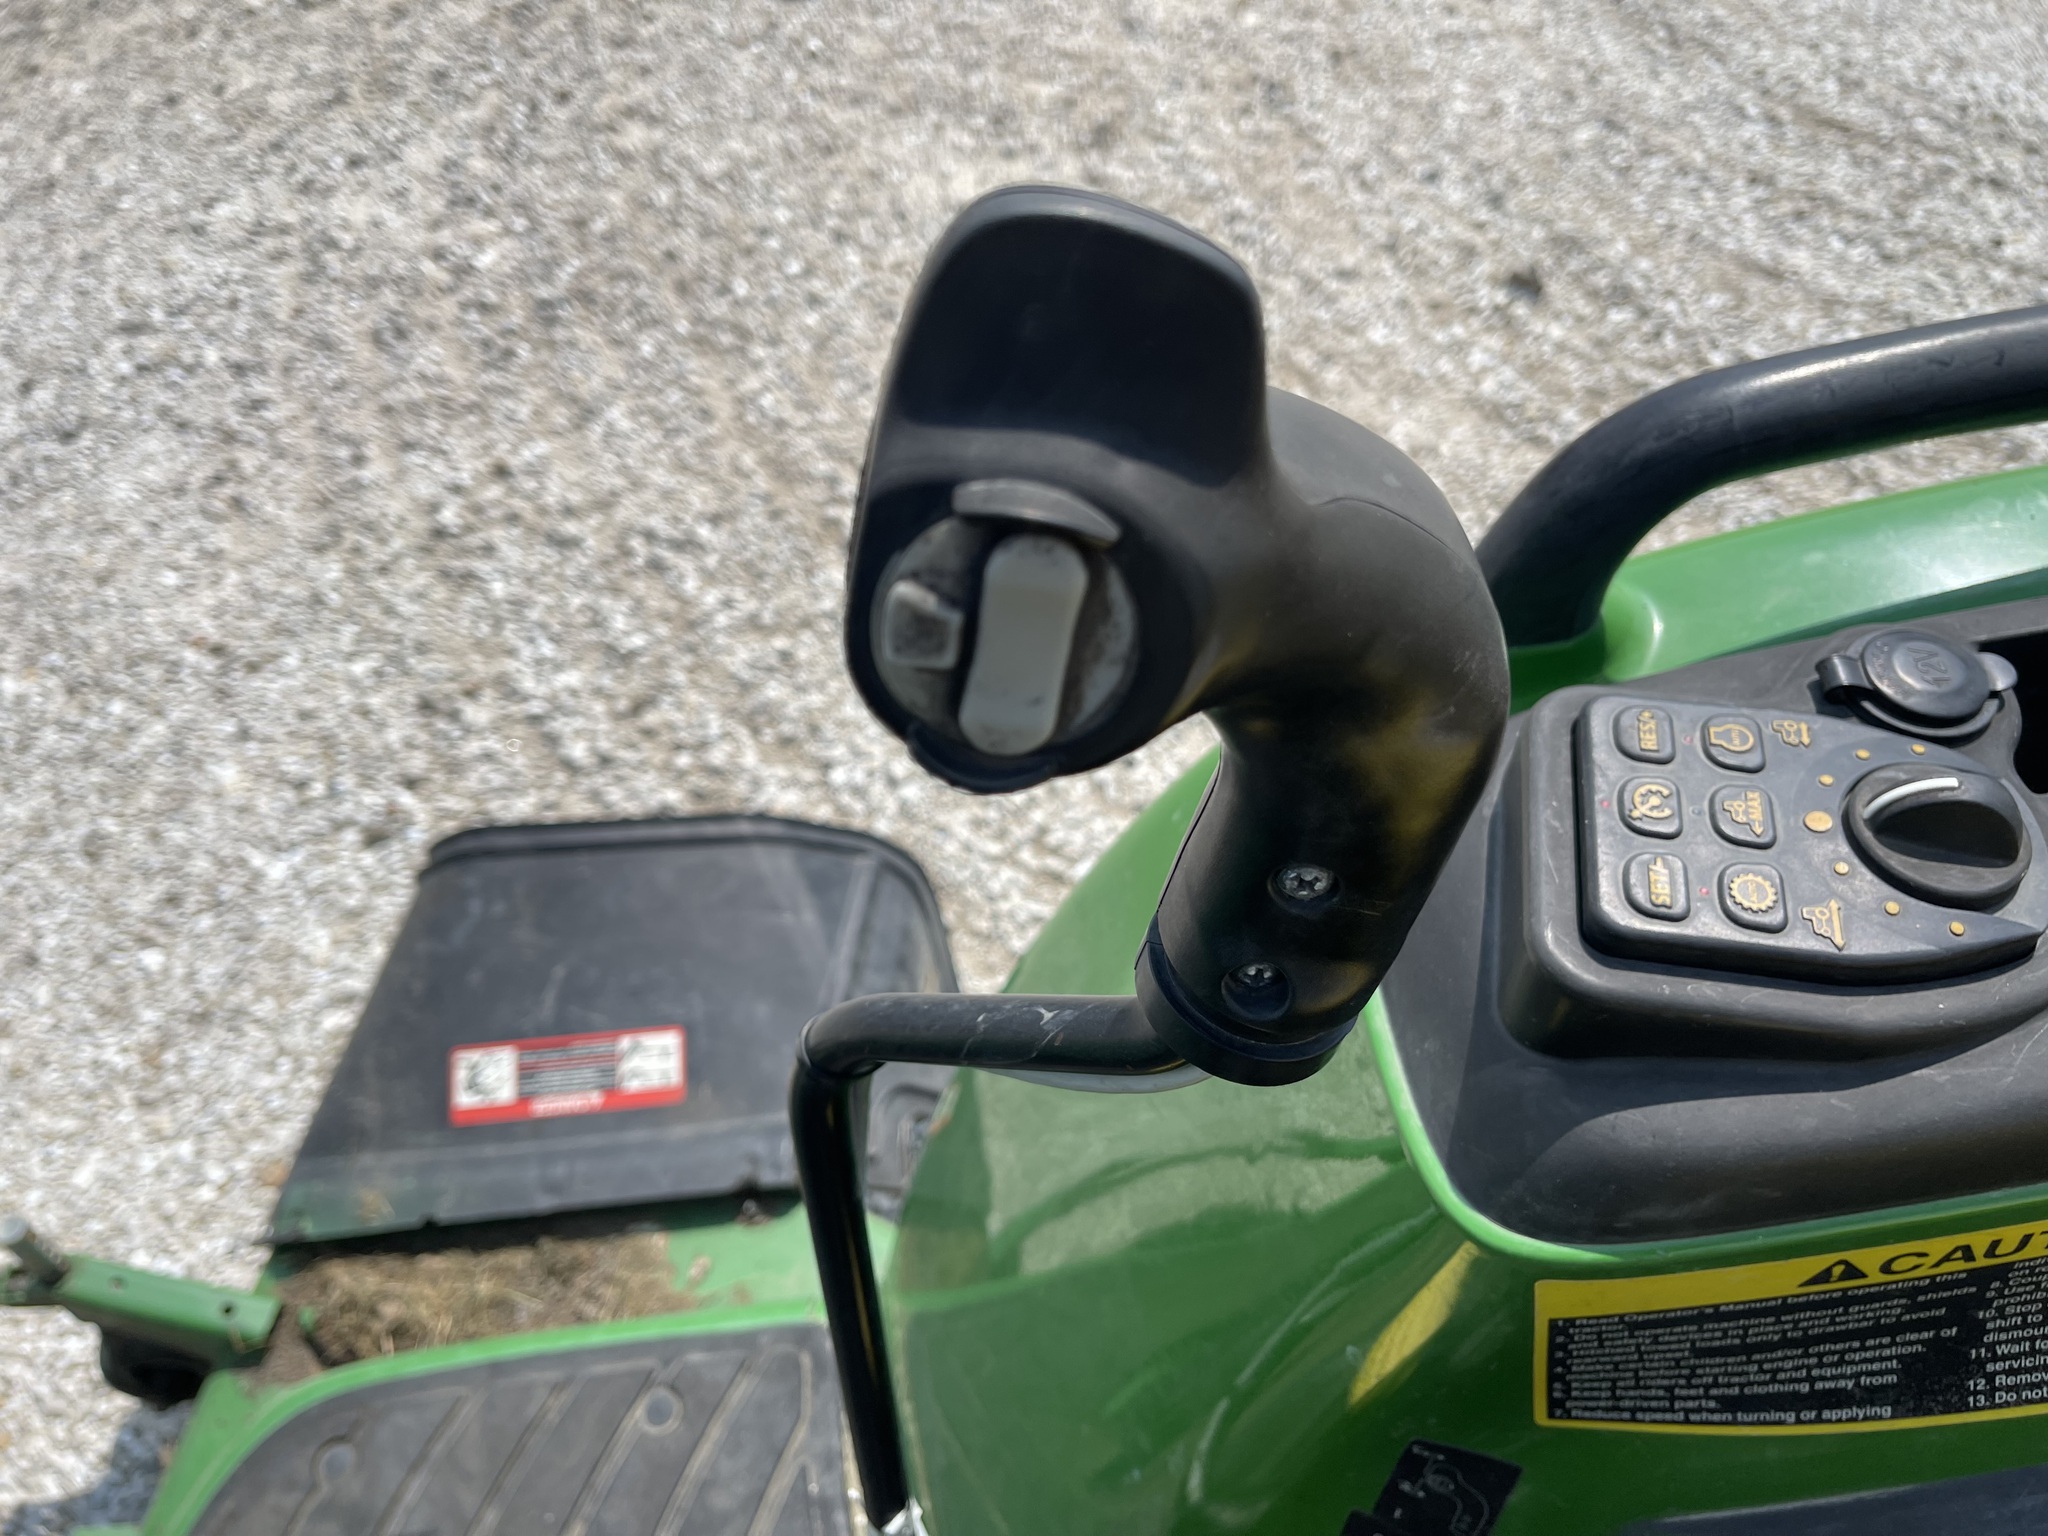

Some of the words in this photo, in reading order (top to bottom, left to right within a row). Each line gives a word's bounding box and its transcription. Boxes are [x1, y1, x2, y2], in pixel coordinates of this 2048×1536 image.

[1906, 647, 1952, 687] 12V
[1879, 1231, 2048, 1275] CAU
[2007, 1268, 2030, 1279] on
[1719, 1298, 1782, 1312] Manual
[1787, 1290, 1843, 1304] before
[1847, 1278, 1931, 1296] operating
[1935, 1272, 1968, 1283] this
[1992, 1291, 2048, 1309] prohib
[2003, 1284, 2036, 1296] Use
[1703, 1316, 1776, 1330] machine
[1780, 1307, 1844, 1321] without
[1917, 1286, 1978, 1302] shields
[1977, 1308, 1999, 1319] 10.
[2004, 1302, 2043, 1316] Stop
[1695, 1337, 1742, 1348] loads
[1746, 1333, 1782, 1344] only
[1787, 1330, 1803, 1339] to
[1807, 1321, 1875, 1335] drawbar
[1880, 1316, 1897, 1325] to
[1901, 1307, 1947, 1322] avoid
[1747, 1322, 1794, 1336] place
[1798, 1317, 1831, 1328] and
[1835, 1307, 1906, 1323] working.
[1986, 1316, 2023, 1330] shift
[2027, 1313, 2043, 1324] to
[1679, 1355, 1747, 1367] children
[1750, 1347, 1805, 1361] and/or
[1808, 1340, 1861, 1355] others
[1865, 1336, 1892, 1348] are
[1895, 1329, 1936, 1343] clear
[1940, 1326, 1959, 1338] of
[1969, 1347, 1992, 1360] 11.
[1995, 1340, 2030, 1356] Wait
[1695, 1362, 1759, 1376] starting
[1762, 1356, 1819, 1371] engine
[1822, 1353, 1841, 1364] or
[1844, 1343, 1927, 1362] operation.
[1717, 1372, 1772, 1385] tractor
[1776, 1368, 1807, 1381] and
[1810, 1358, 1902, 1378] equipment.
[1708, 1385, 1740, 1396] and
[1743, 1380, 1810, 1395] clothing
[1814, 1378, 1855, 1391] away
[1860, 1373, 1898, 1386] from
[1968, 1378, 1990, 1392] 12.
[1967, 1394, 1991, 1408] 13.
[1994, 1391, 2018, 1404] Do
[2022, 1385, 2048, 1400] not
[1688, 1411, 1733, 1422] when
[1736, 1410, 1796, 1424] turning
[1799, 1410, 1818, 1421] or
[1821, 1404, 1893, 1421] applying
